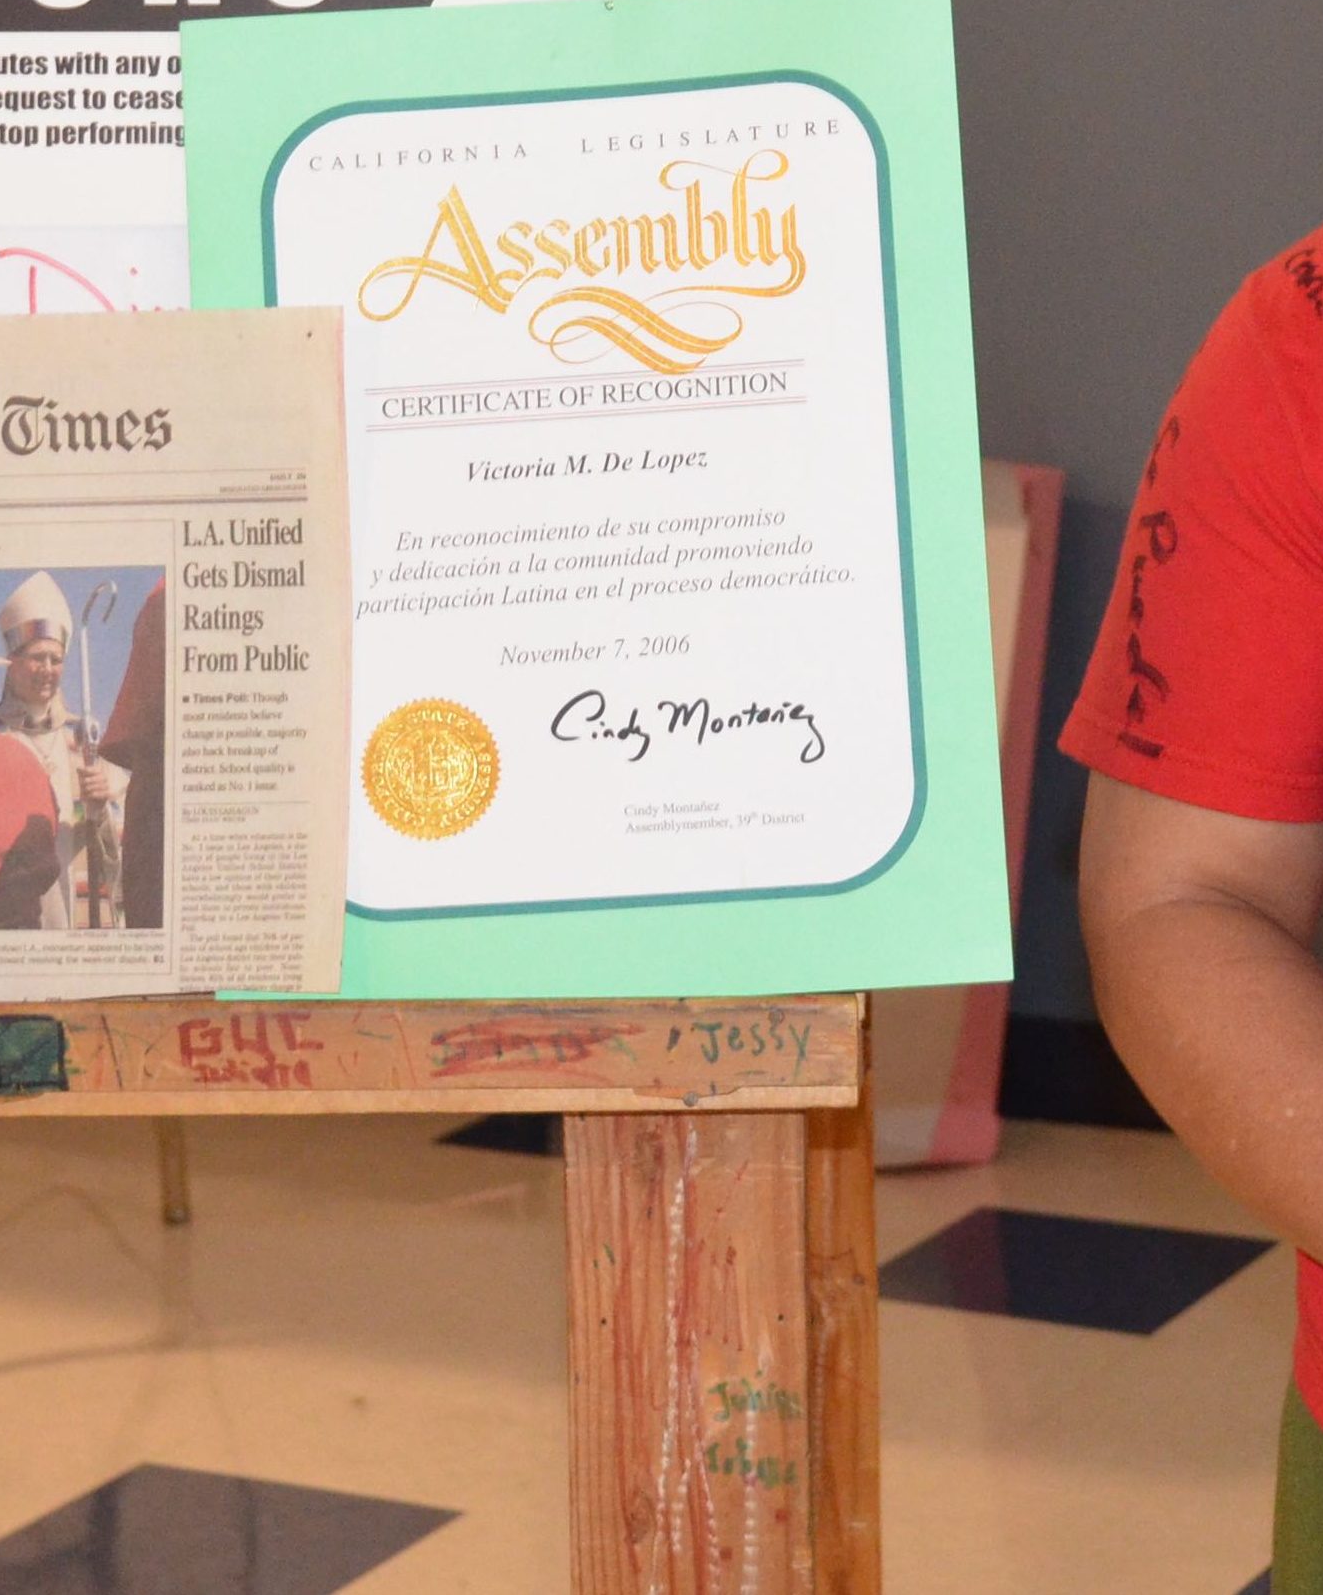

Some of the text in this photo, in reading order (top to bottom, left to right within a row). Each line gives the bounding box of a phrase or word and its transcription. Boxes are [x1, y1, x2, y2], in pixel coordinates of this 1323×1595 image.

[55, 51, 108, 75] with
[115, 53, 160, 77] any
[82, 87, 106, 109] to
[46, 121, 185, 147] performing
[309, 119, 841, 172] CALIFORNIA LEGISLATURE
[356, 149, 807, 376] Assembly
[381, 371, 789, 420] CERTIFICATE OF RECOGNITION
[1, 395, 173, 457] Times
[468, 448, 708, 482] Victoria M. De Lopez
[183, 517, 304, 547] L.A. Unified
[396, 507, 786, 552] En reconocimiento de su compromiso
[183, 559, 305, 588] Gets Dismal
[370, 534, 814, 589] y dedicación a la comunidad promoviendo
[355, 562, 857, 620] participación Latina en el proceso democrático.
[183, 603, 265, 636] Ratings
[183, 644, 310, 672] From Public
[500, 633, 691, 667] November 7, 2006
[550, 689, 651, 762] Cindy
[624, 799, 720, 820] Cindy Montañez
[625, 810, 805, 835] Assemblymember, 39th District
[692, 1020, 810, 1086] Jessy
